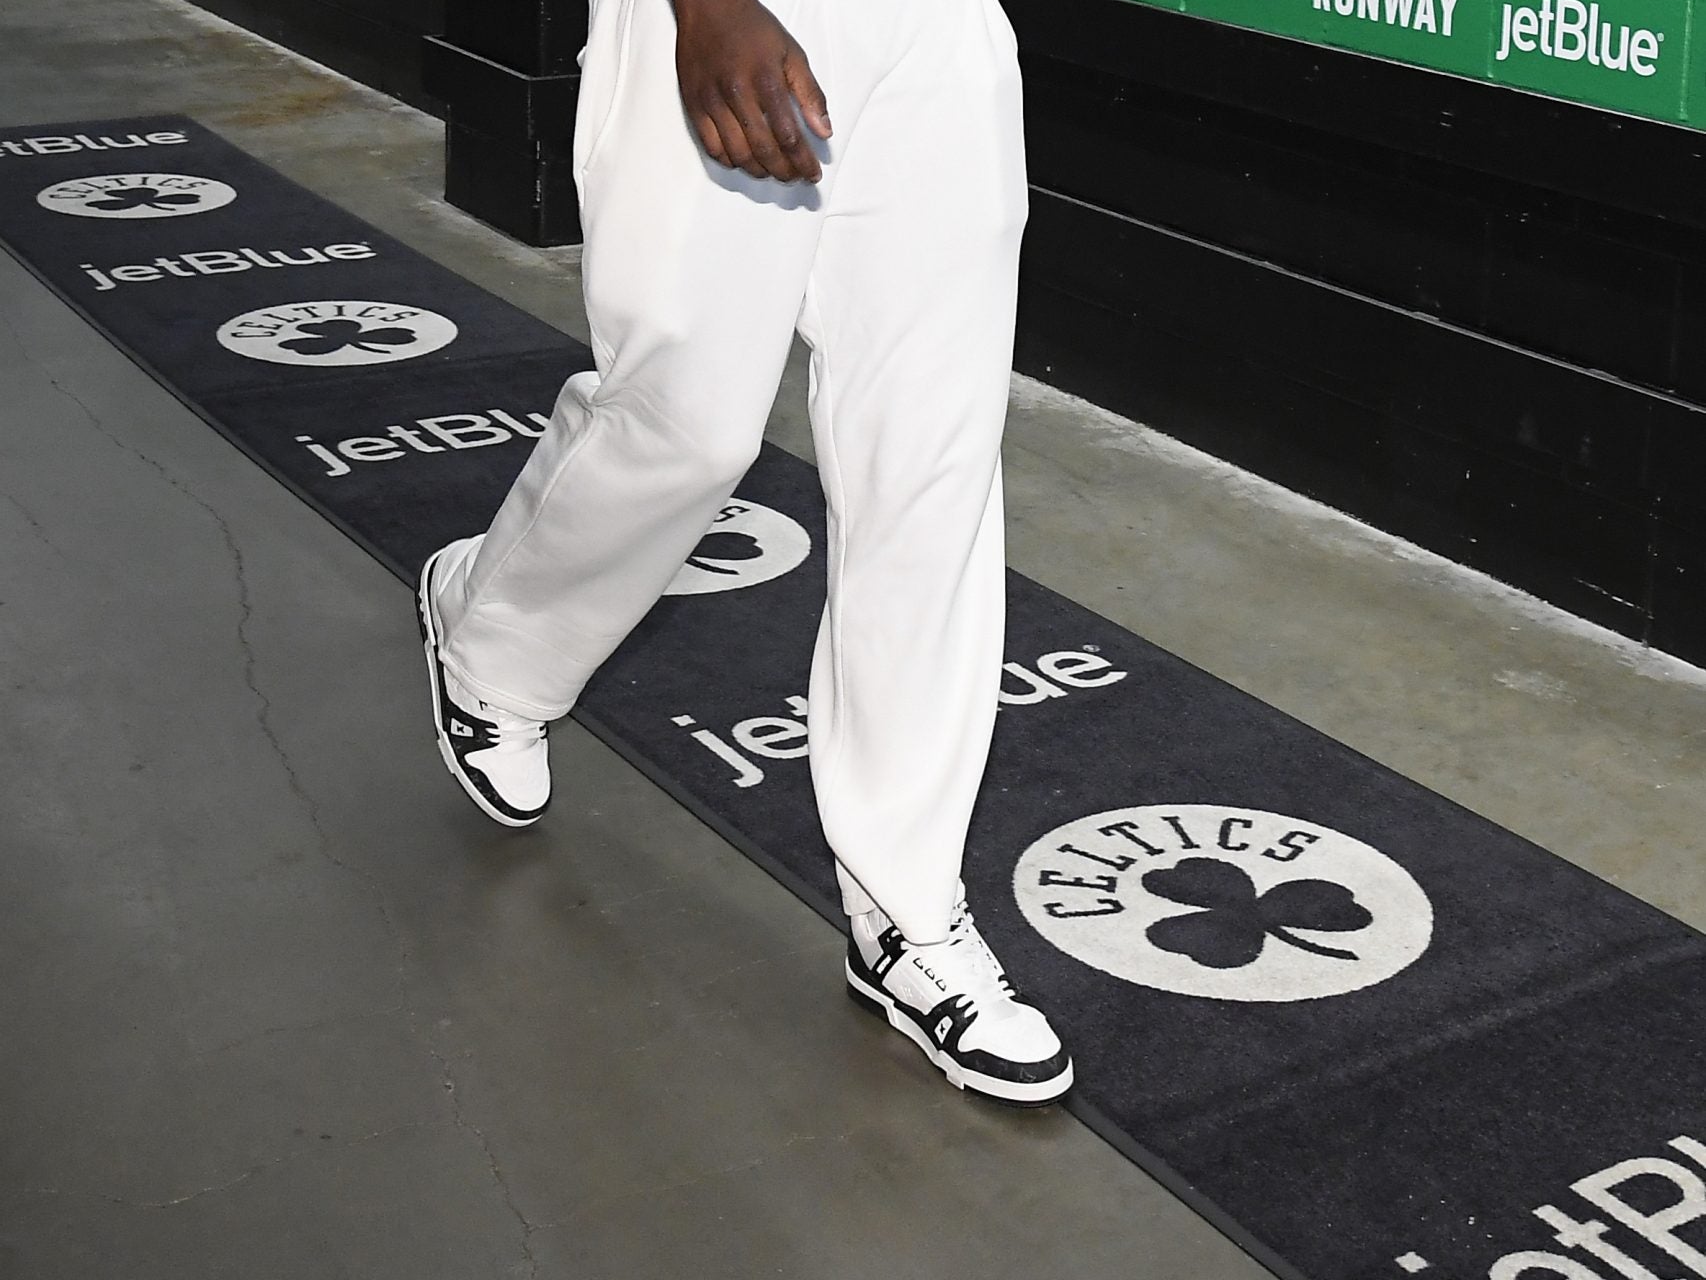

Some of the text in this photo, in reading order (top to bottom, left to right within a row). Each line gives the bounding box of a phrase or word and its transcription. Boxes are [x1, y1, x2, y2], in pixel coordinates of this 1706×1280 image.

[0, 130, 189, 158] tBlue
[48, 176, 209, 200] CELTICS
[79, 241, 377, 290] jetBlue
[231, 303, 419, 339] CELTICS
[1038, 814, 1322, 922] CELTICS
